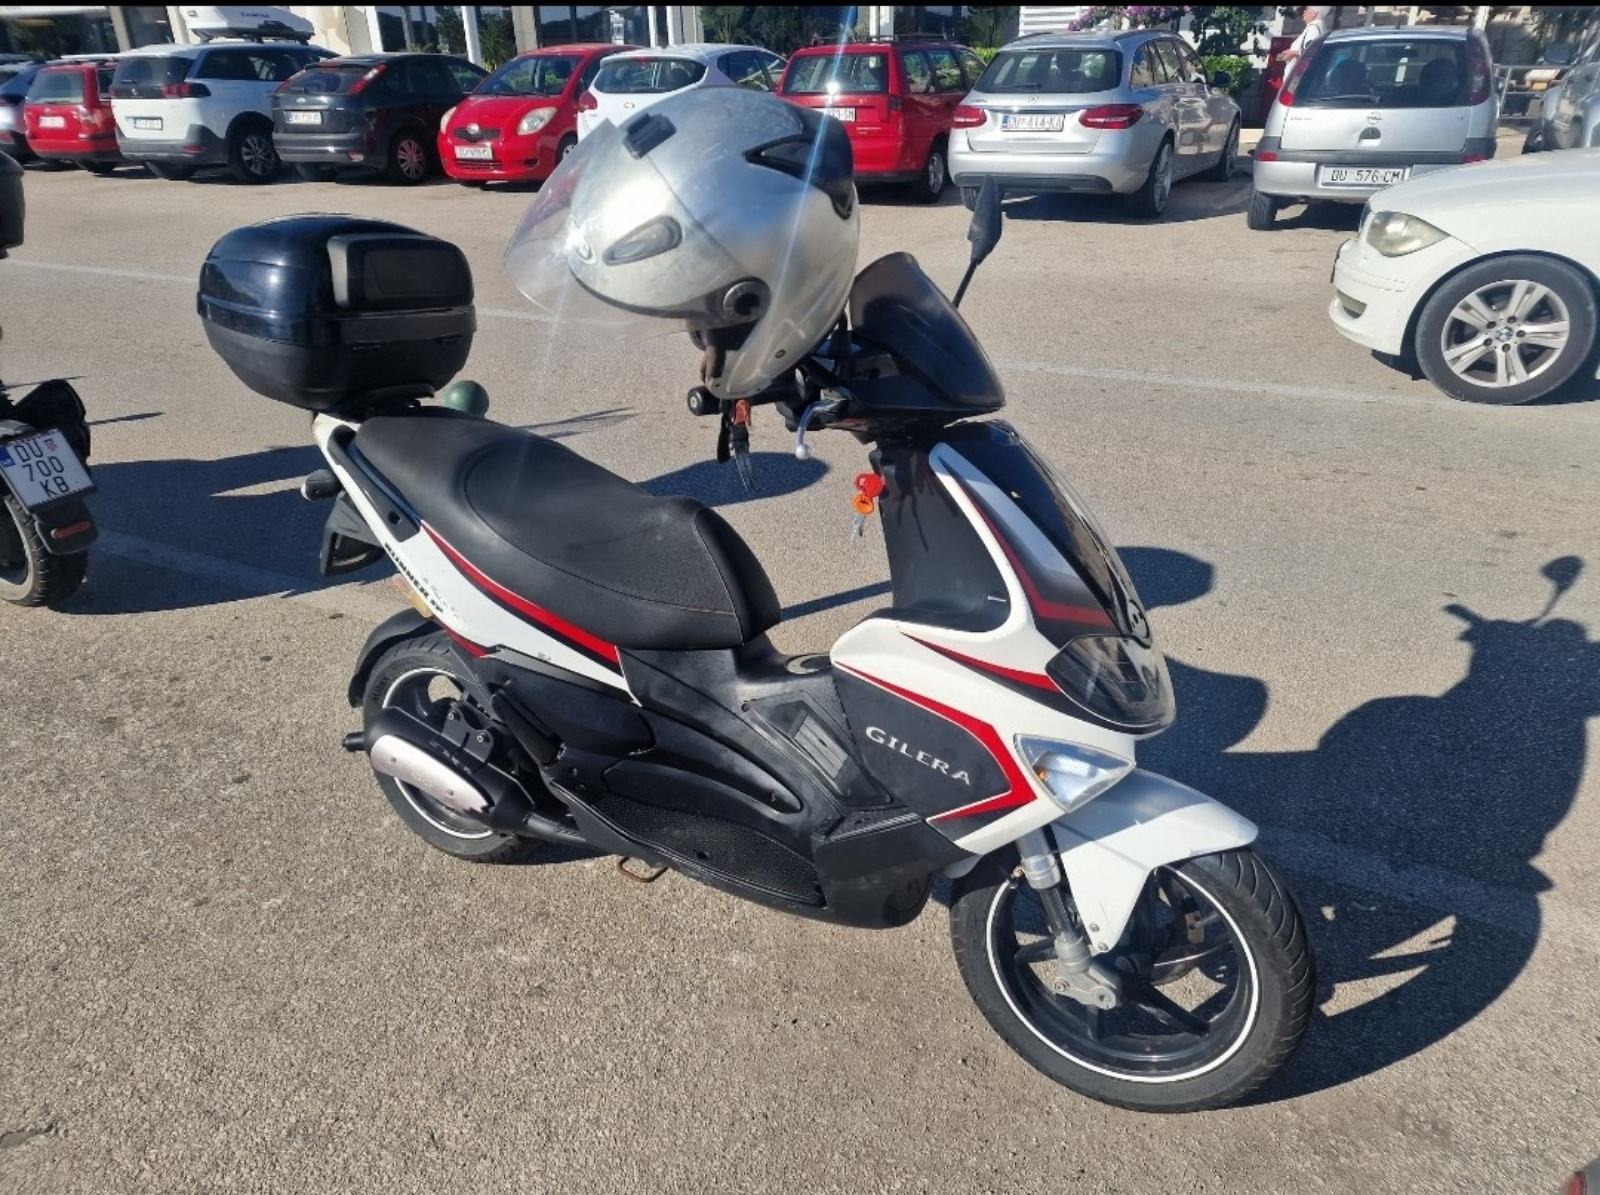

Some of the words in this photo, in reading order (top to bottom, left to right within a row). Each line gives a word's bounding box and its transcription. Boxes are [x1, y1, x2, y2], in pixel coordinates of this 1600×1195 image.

[1330, 169, 1347, 182] DU
[14, 437, 43, 462] DU
[22, 455, 64, 482] 700
[40, 475, 70, 497] KB
[865, 725, 971, 786] GILERA
